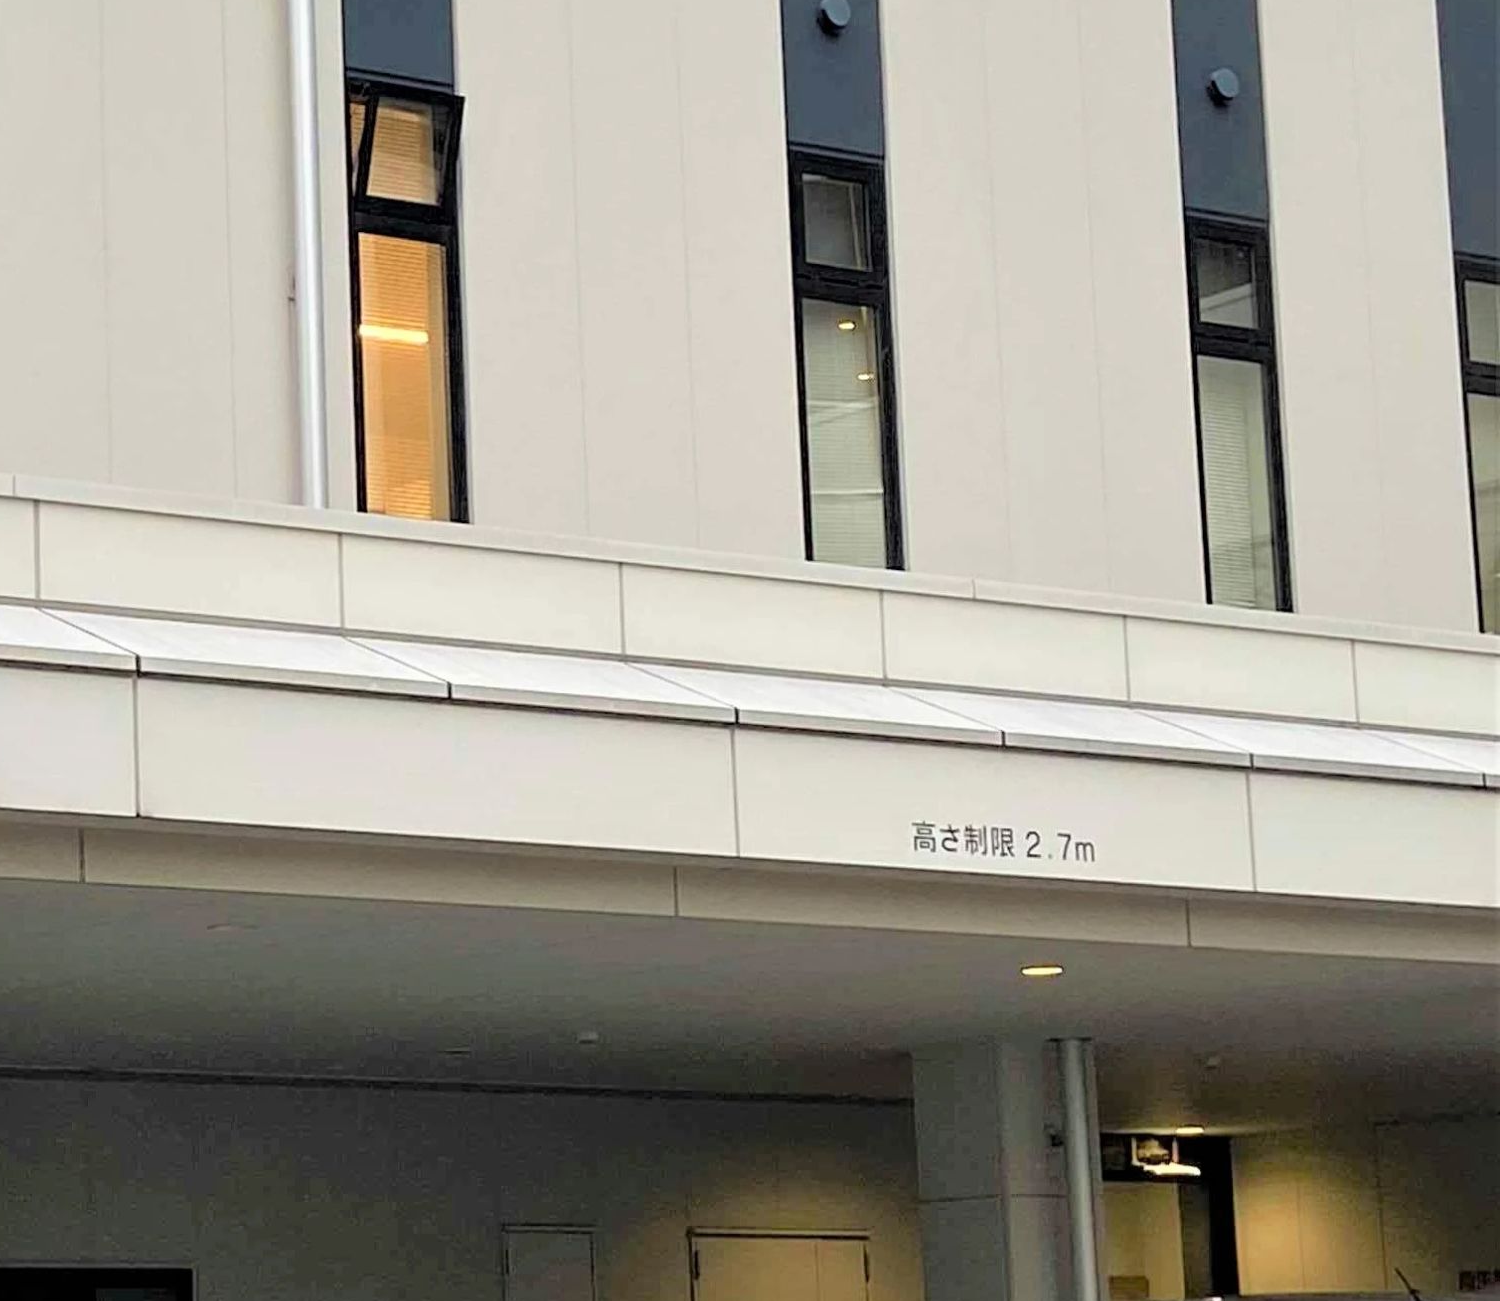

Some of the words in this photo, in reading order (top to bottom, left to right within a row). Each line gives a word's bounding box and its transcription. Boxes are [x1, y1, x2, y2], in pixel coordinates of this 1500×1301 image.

[911, 820, 1016, 858] 高さ制限
[1025, 830, 1097, 863] 2.7m
